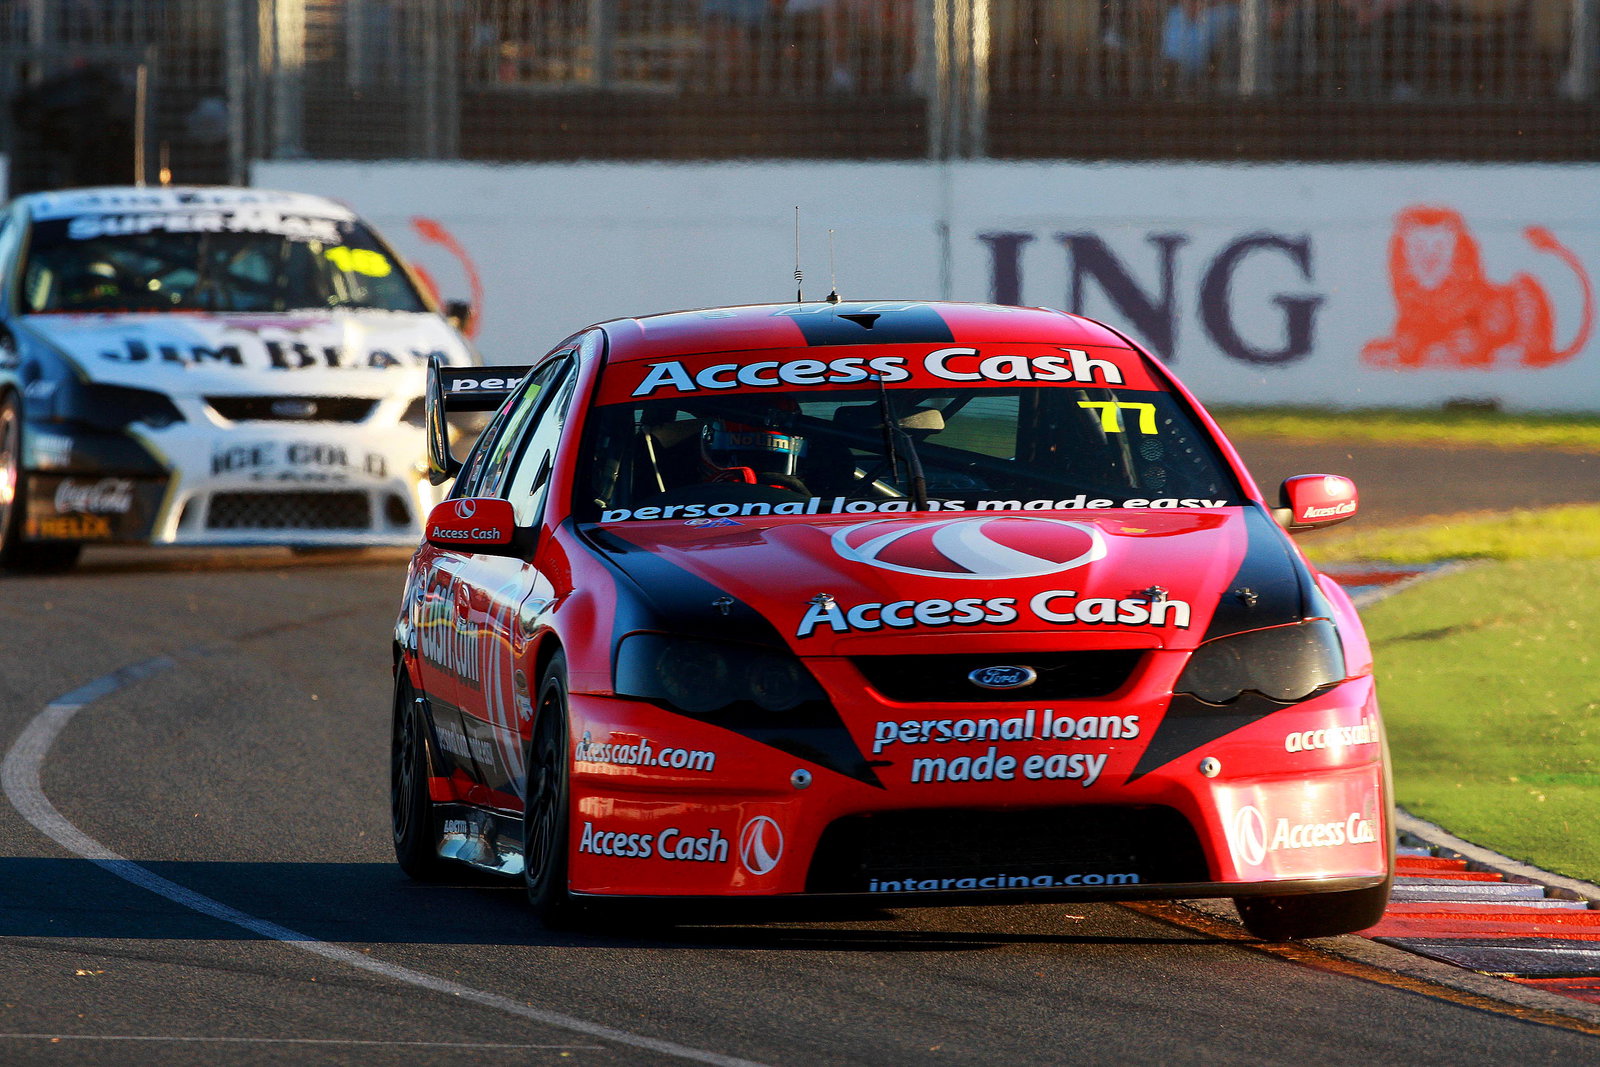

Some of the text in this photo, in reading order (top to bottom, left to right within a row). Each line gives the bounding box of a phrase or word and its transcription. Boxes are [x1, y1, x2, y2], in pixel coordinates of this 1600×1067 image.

[974, 229, 1328, 369] ING
[630, 346, 1125, 398] Access Cash
[1076, 401, 1159, 435] 77
[600, 496, 822, 524] personal
[830, 495, 966, 514] loans
[976, 494, 1112, 511] made
[1122, 497, 1228, 510] easy
[432, 526, 501, 540] Access Cash
[796, 588, 1193, 638] Access Cash
[982, 668, 1021, 684] Ford
[871, 709, 1141, 754] personal loans
[910, 745, 1109, 788] made easy
[579, 821, 730, 863] Access Cash
[1270, 817, 1347, 851] Access
[868, 873, 1141, 893] intaracing.com
